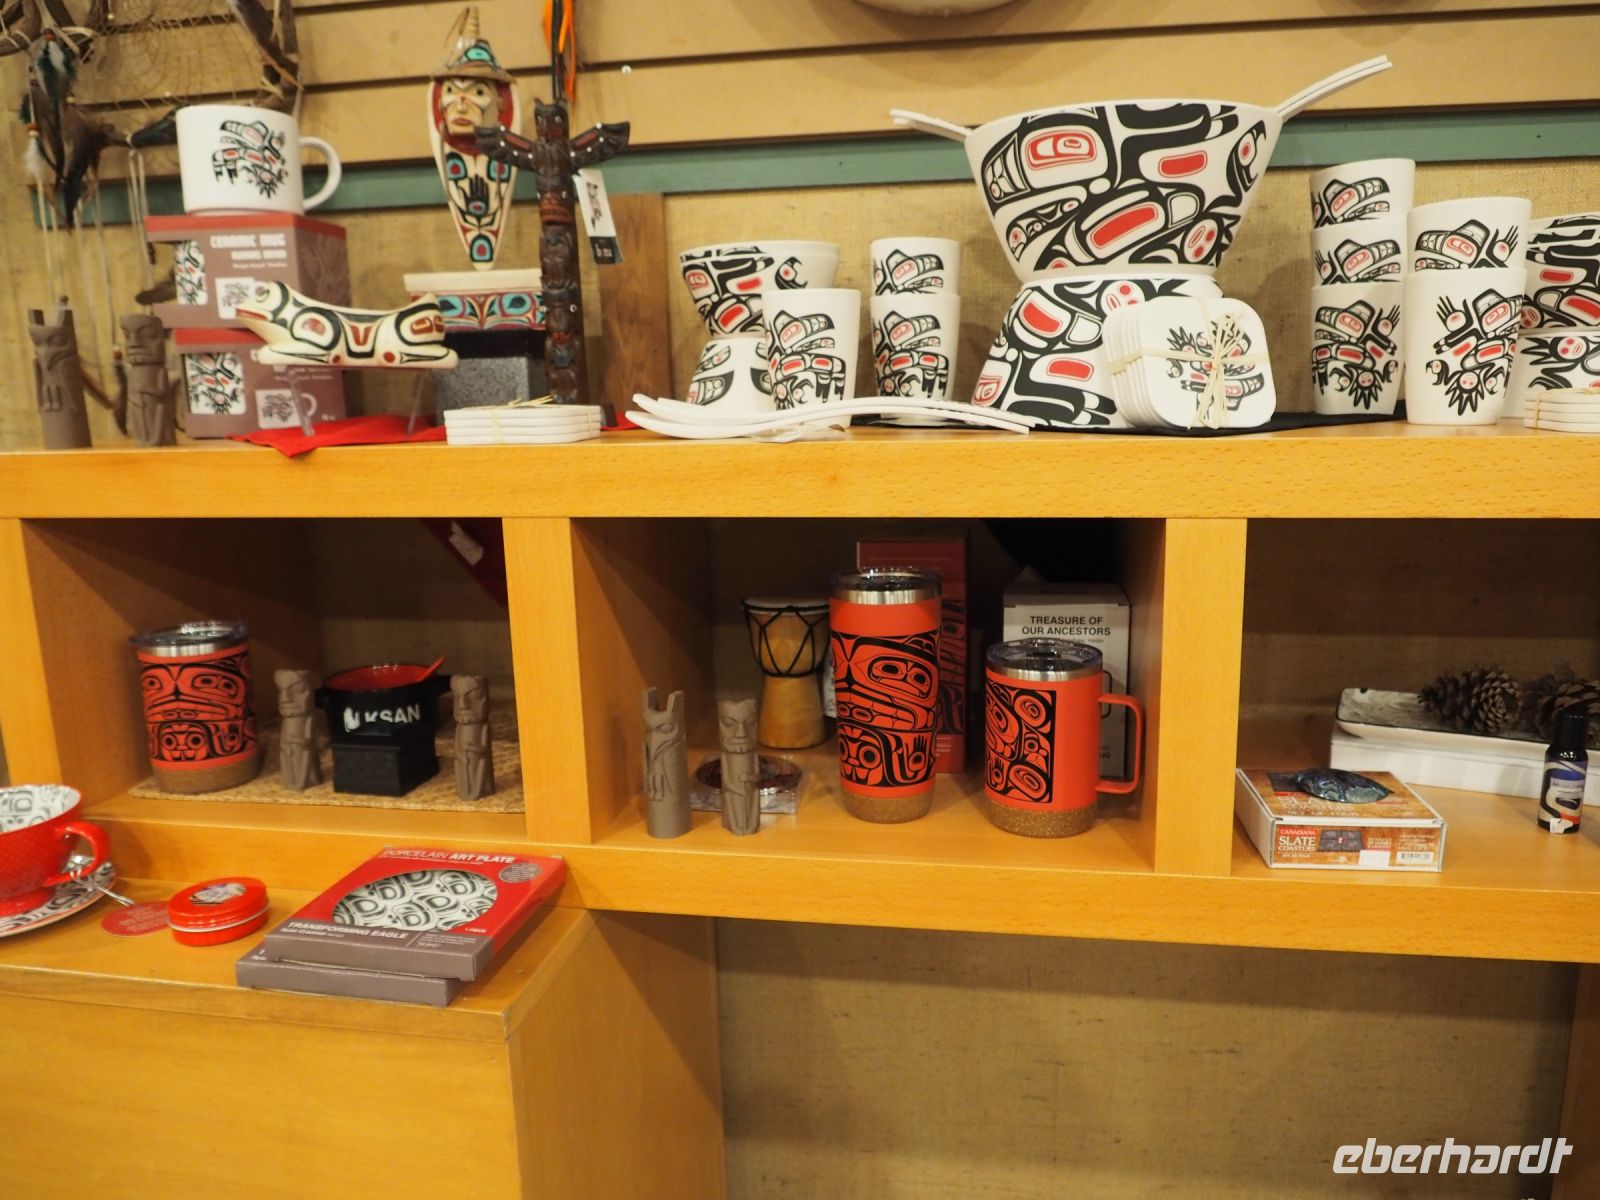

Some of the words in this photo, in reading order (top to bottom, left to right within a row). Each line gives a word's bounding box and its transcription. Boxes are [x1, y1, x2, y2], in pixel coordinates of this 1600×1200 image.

[1029, 616, 1086, 625] TREASURE
[1088, 616, 1104, 625] OF
[1021, 626, 1045, 635] OUR
[1047, 626, 1112, 636] ANCESTORS
[1280, 828, 1316, 836] CANADIANA
[1279, 836, 1317, 846] SLATE
[449, 852, 476, 861] ART
[475, 854, 517, 864] PLATE
[287, 921, 370, 936] TRANSFORMING
[370, 930, 409, 939] EAGLE
